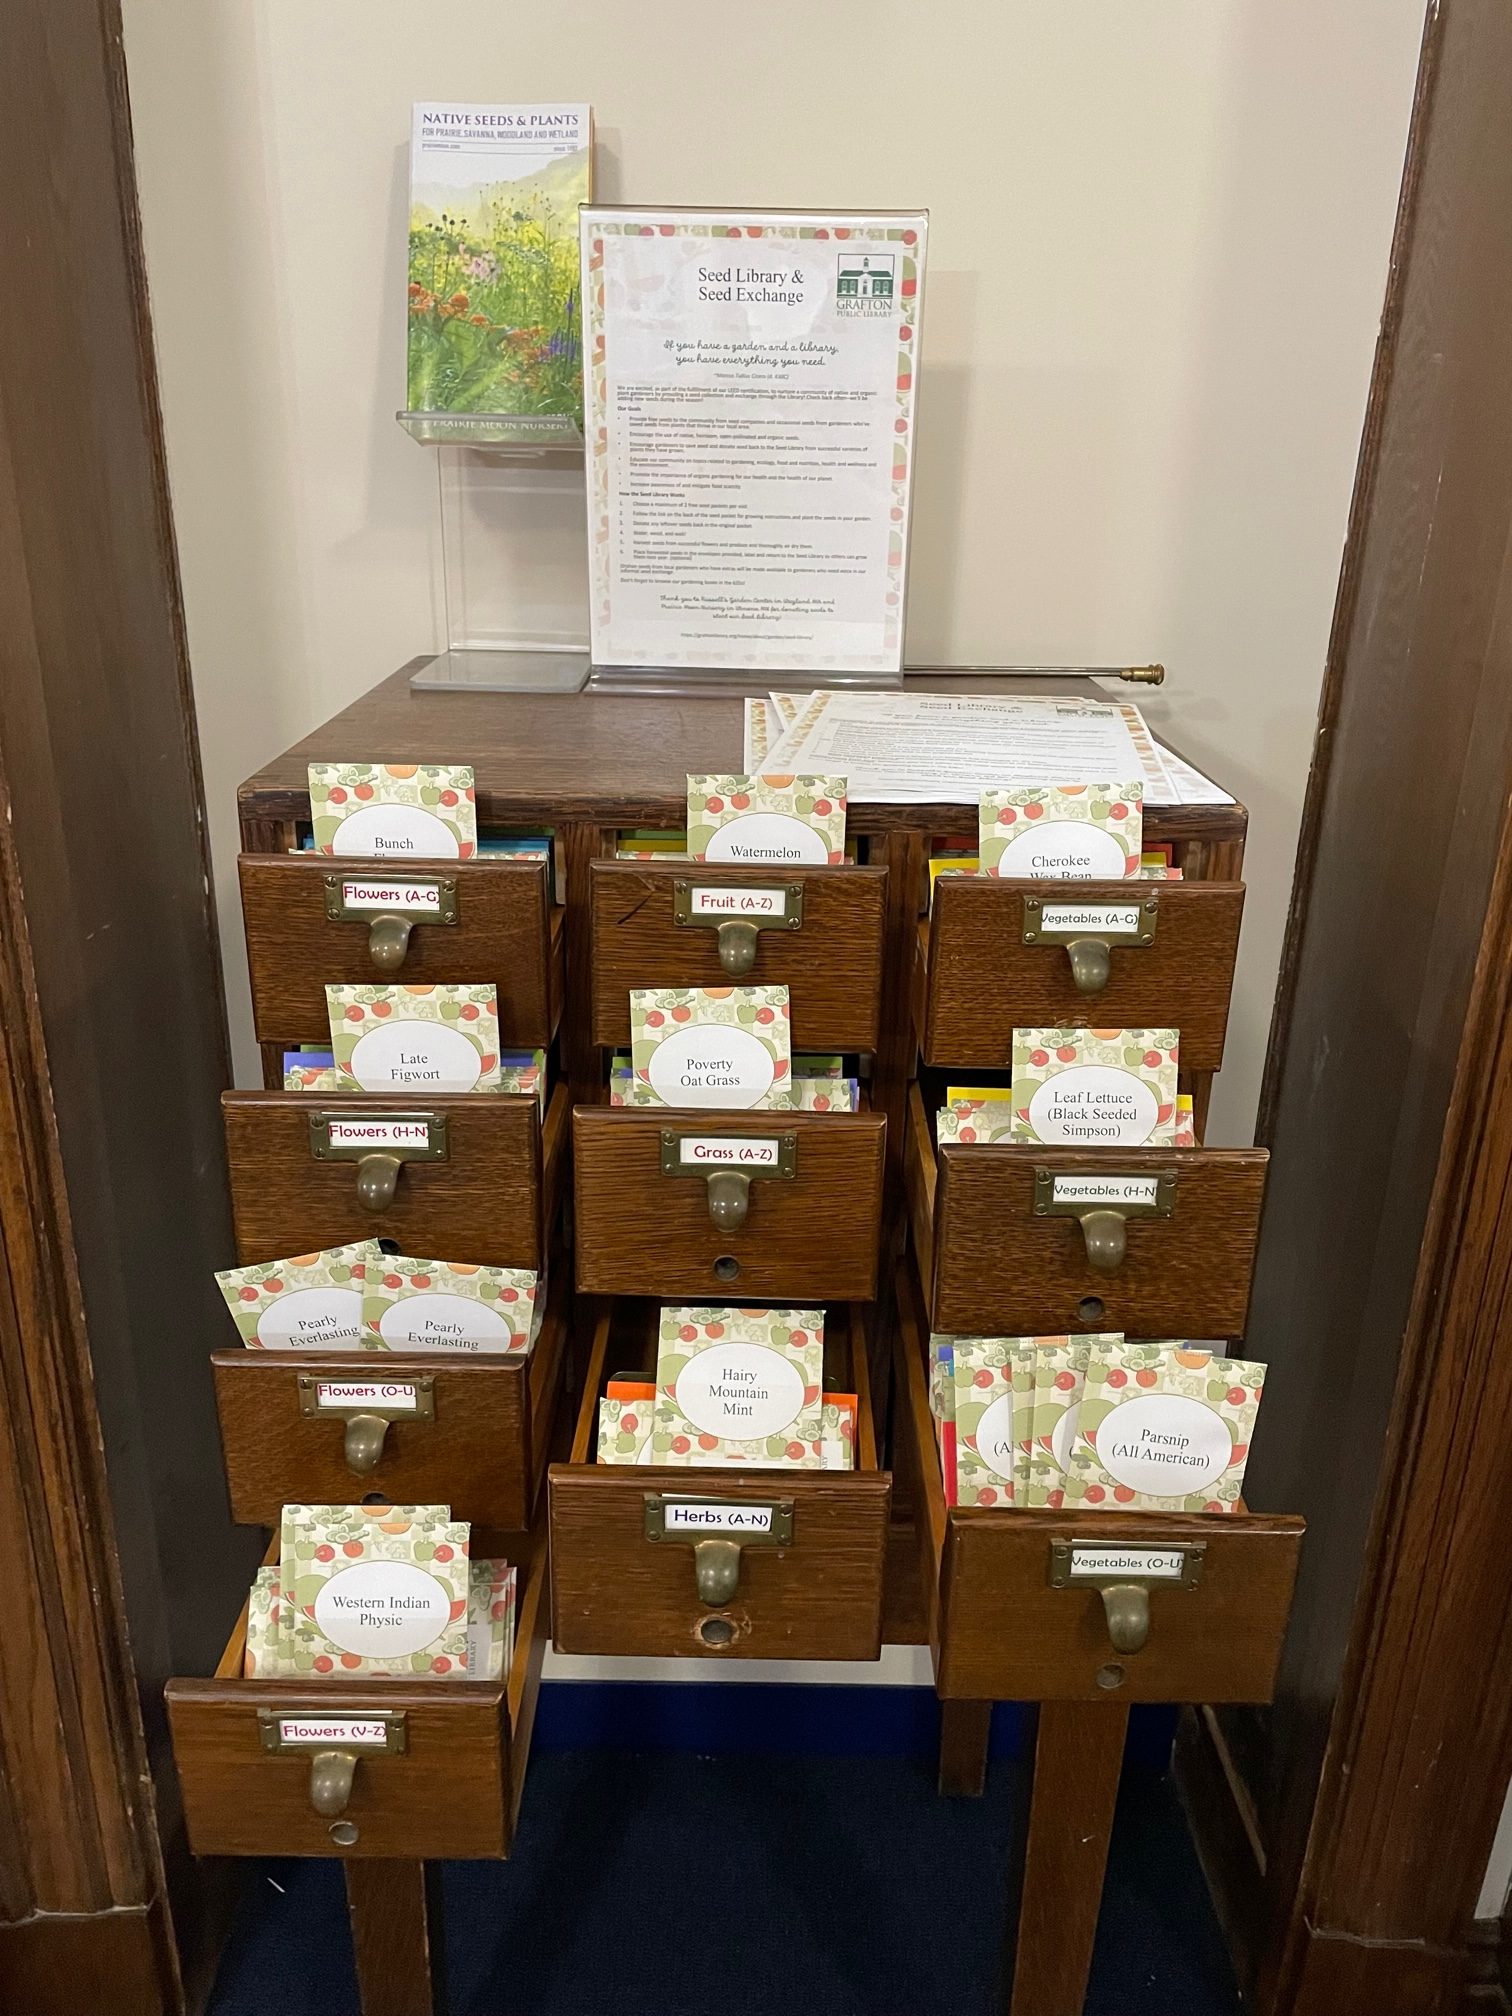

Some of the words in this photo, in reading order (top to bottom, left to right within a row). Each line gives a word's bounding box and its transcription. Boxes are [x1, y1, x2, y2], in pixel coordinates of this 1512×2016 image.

[423, 113, 472, 125] NATIVE
[474, 115, 513, 126] SEEDS
[517, 115, 526, 126] &
[531, 114, 578, 126] PLANTS
[423, 128, 434, 137] FOR
[534, 130, 547, 139] AND
[549, 130, 578, 139] WETLAND
[699, 268, 731, 282] Seed
[736, 268, 787, 286] Library
[792, 270, 804, 283] &
[699, 287, 732, 301] Seed
[737, 288, 804, 305] Exchange
[837, 300, 892, 310] GRAFTON
[663, 340, 674, 351] If
[676, 343, 695, 352] you
[697, 340, 721, 350] have
[732, 340, 767, 353] garden
[769, 341, 789, 351] and
[676, 356, 695, 365] you
[697, 354, 721, 364] have
[723, 355, 779, 367] everything
[781, 358, 800, 368] you
[802, 357, 825, 366] need.
[375, 837, 414, 849] Bunch
[731, 845, 801, 859] Watermelon
[1032, 855, 1090, 867] Cherokee
[344, 886, 400, 901] Flowers
[701, 895, 735, 908] Fruit
[740, 897, 773, 910] (A-Z)
[1105, 913, 1138, 925] (A-G)
[400, 1053, 428, 1065] Late
[687, 1059, 733, 1071] Poverty
[391, 1069, 440, 1082] Figwort
[681, 1074, 702, 1087] Oat
[706, 1074, 740, 1086] Grass
[1054, 1092, 1084, 1104] Leaf
[1086, 1092, 1133, 1104] Lettuce
[1047, 1108, 1088, 1121] (Black
[1093, 1108, 1137, 1120] Seeded
[329, 1125, 387, 1138] Flowers
[1062, 1124, 1121, 1138] Simpson)
[694, 1146, 733, 1159] Grass
[739, 1148, 773, 1162] (A-Z)
[1055, 1184, 1119, 1198] Vegetables
[1124, 1185, 1157, 1198] (H-N
[298, 1314, 337, 1331] Pearly
[425, 1320, 465, 1335] Pearly
[289, 1325, 360, 1347] Everlasting
[408, 1332, 479, 1351] Everlasting
[722, 1369, 757, 1384] Hairy
[319, 1385, 376, 1397] Flowers
[709, 1385, 768, 1400] Mountain
[723, 1403, 753, 1416] Mint
[1141, 1428, 1190, 1449] Parsnip
[1112, 1444, 1139, 1459] (All
[1142, 1449, 1210, 1469] American)
[674, 1510, 722, 1523] Herbs
[728, 1513, 768, 1526] (A-N)
[1072, 1555, 1142, 1568] Vegetables
[332, 1596, 385, 1608] Western
[389, 1596, 430, 1609] Indian
[359, 1614, 403, 1628] Physic
[283, 1725, 345, 1738] Flowers
[351, 1726, 386, 1739] (V-Z)
